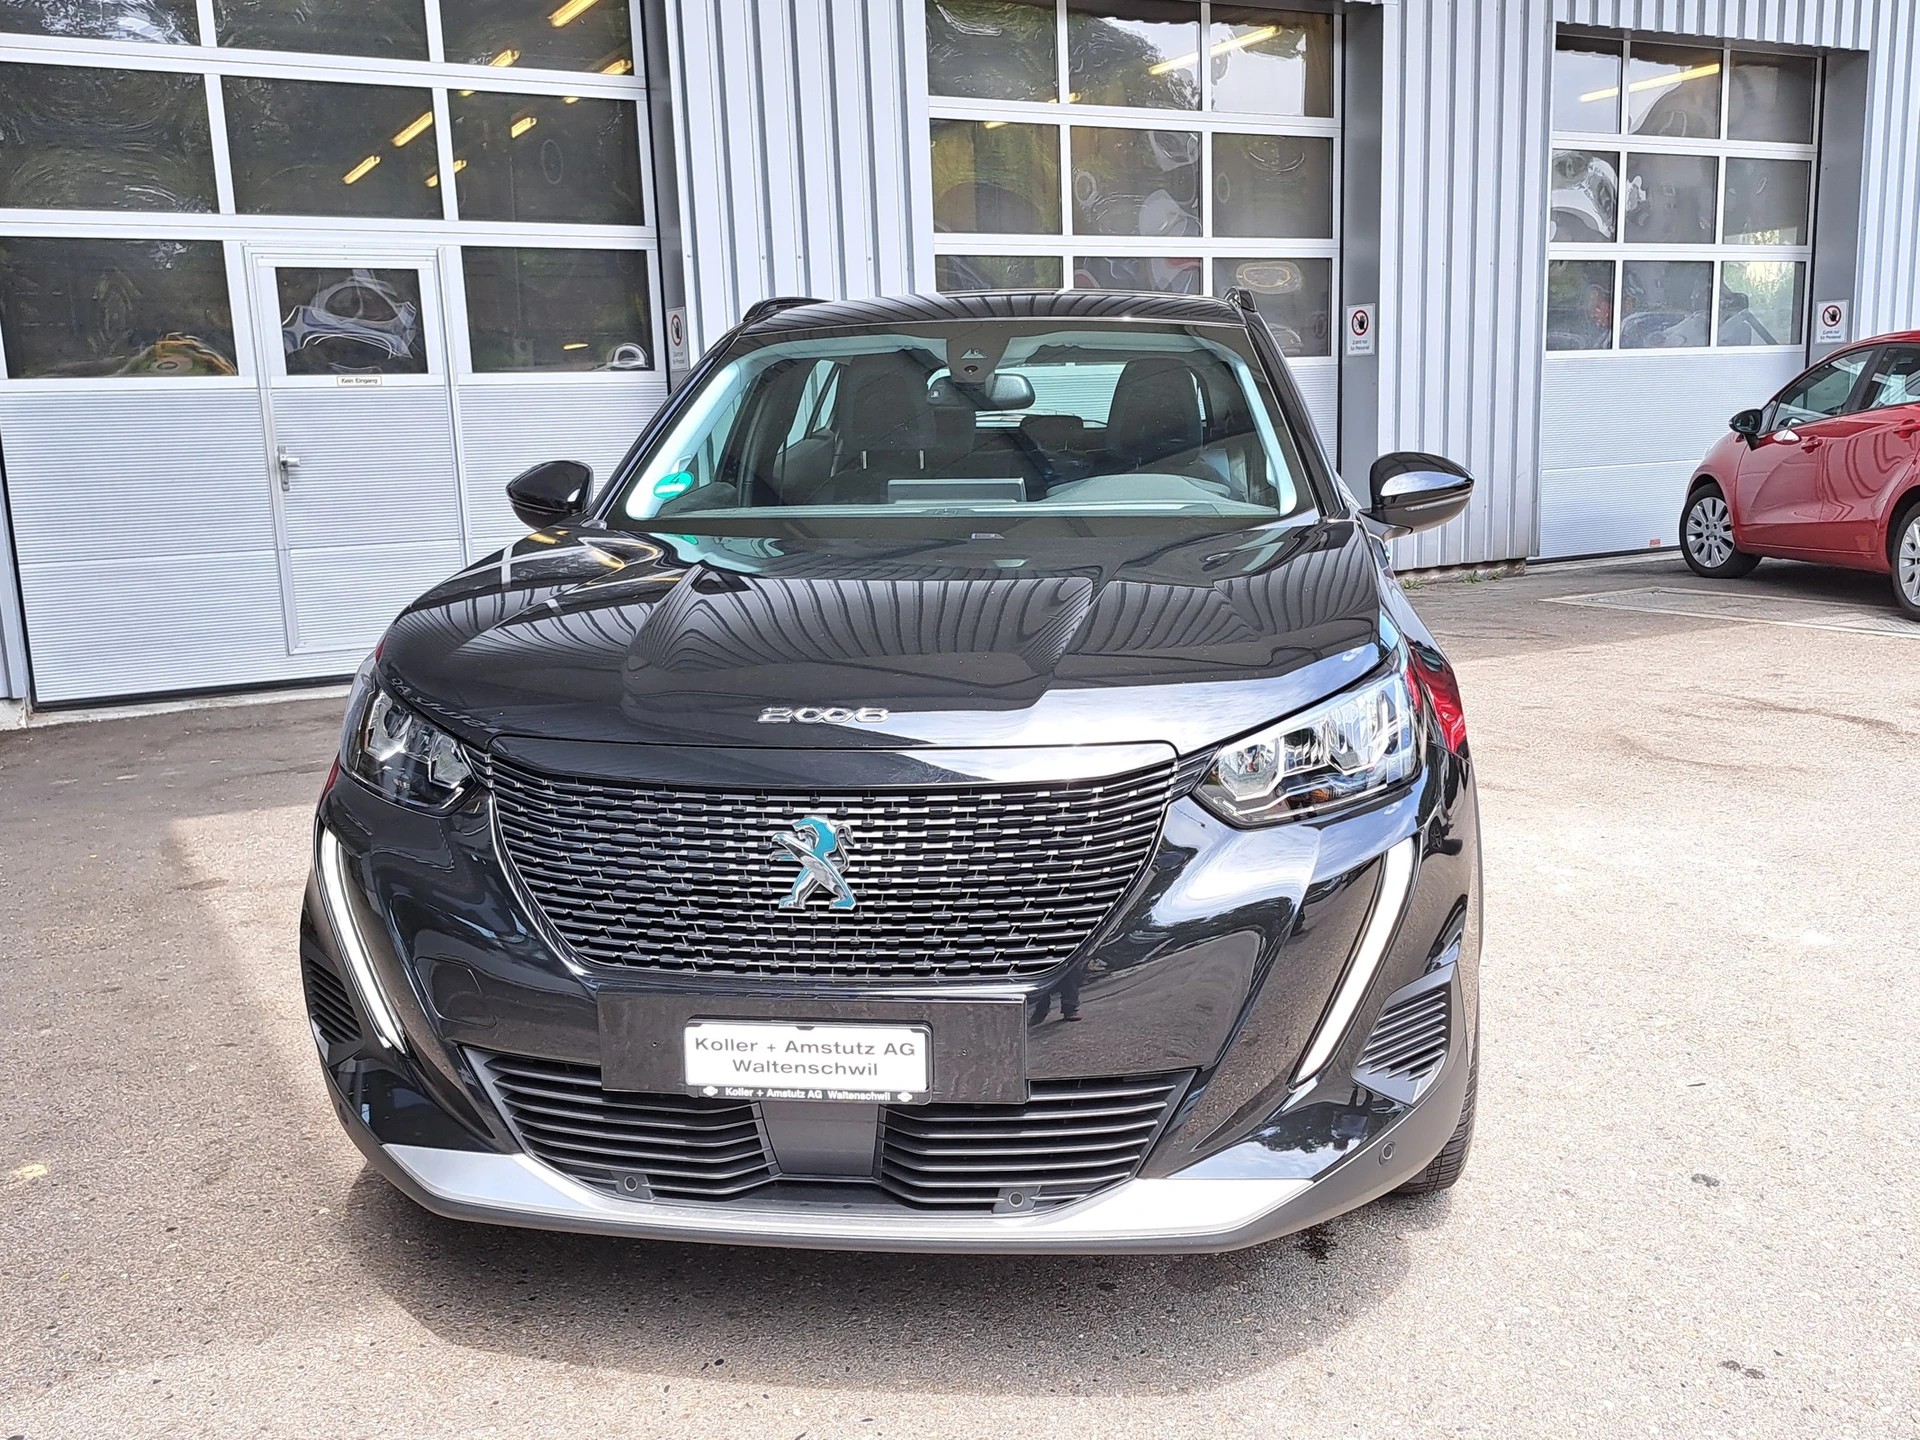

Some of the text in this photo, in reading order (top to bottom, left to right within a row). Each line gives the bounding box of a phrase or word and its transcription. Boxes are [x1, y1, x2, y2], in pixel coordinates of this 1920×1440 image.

[355, 377, 378, 385] Eingang
[757, 706, 889, 724] 2008
[695, 1037, 916, 1057] Koller + Amstutz AG
[732, 1058, 878, 1077] Waltenschwil
[725, 1086, 755, 1098] Koller
[766, 1088, 806, 1100] Amstutz
[807, 1089, 823, 1100] AG
[827, 1089, 891, 1102] Waltenschwil
